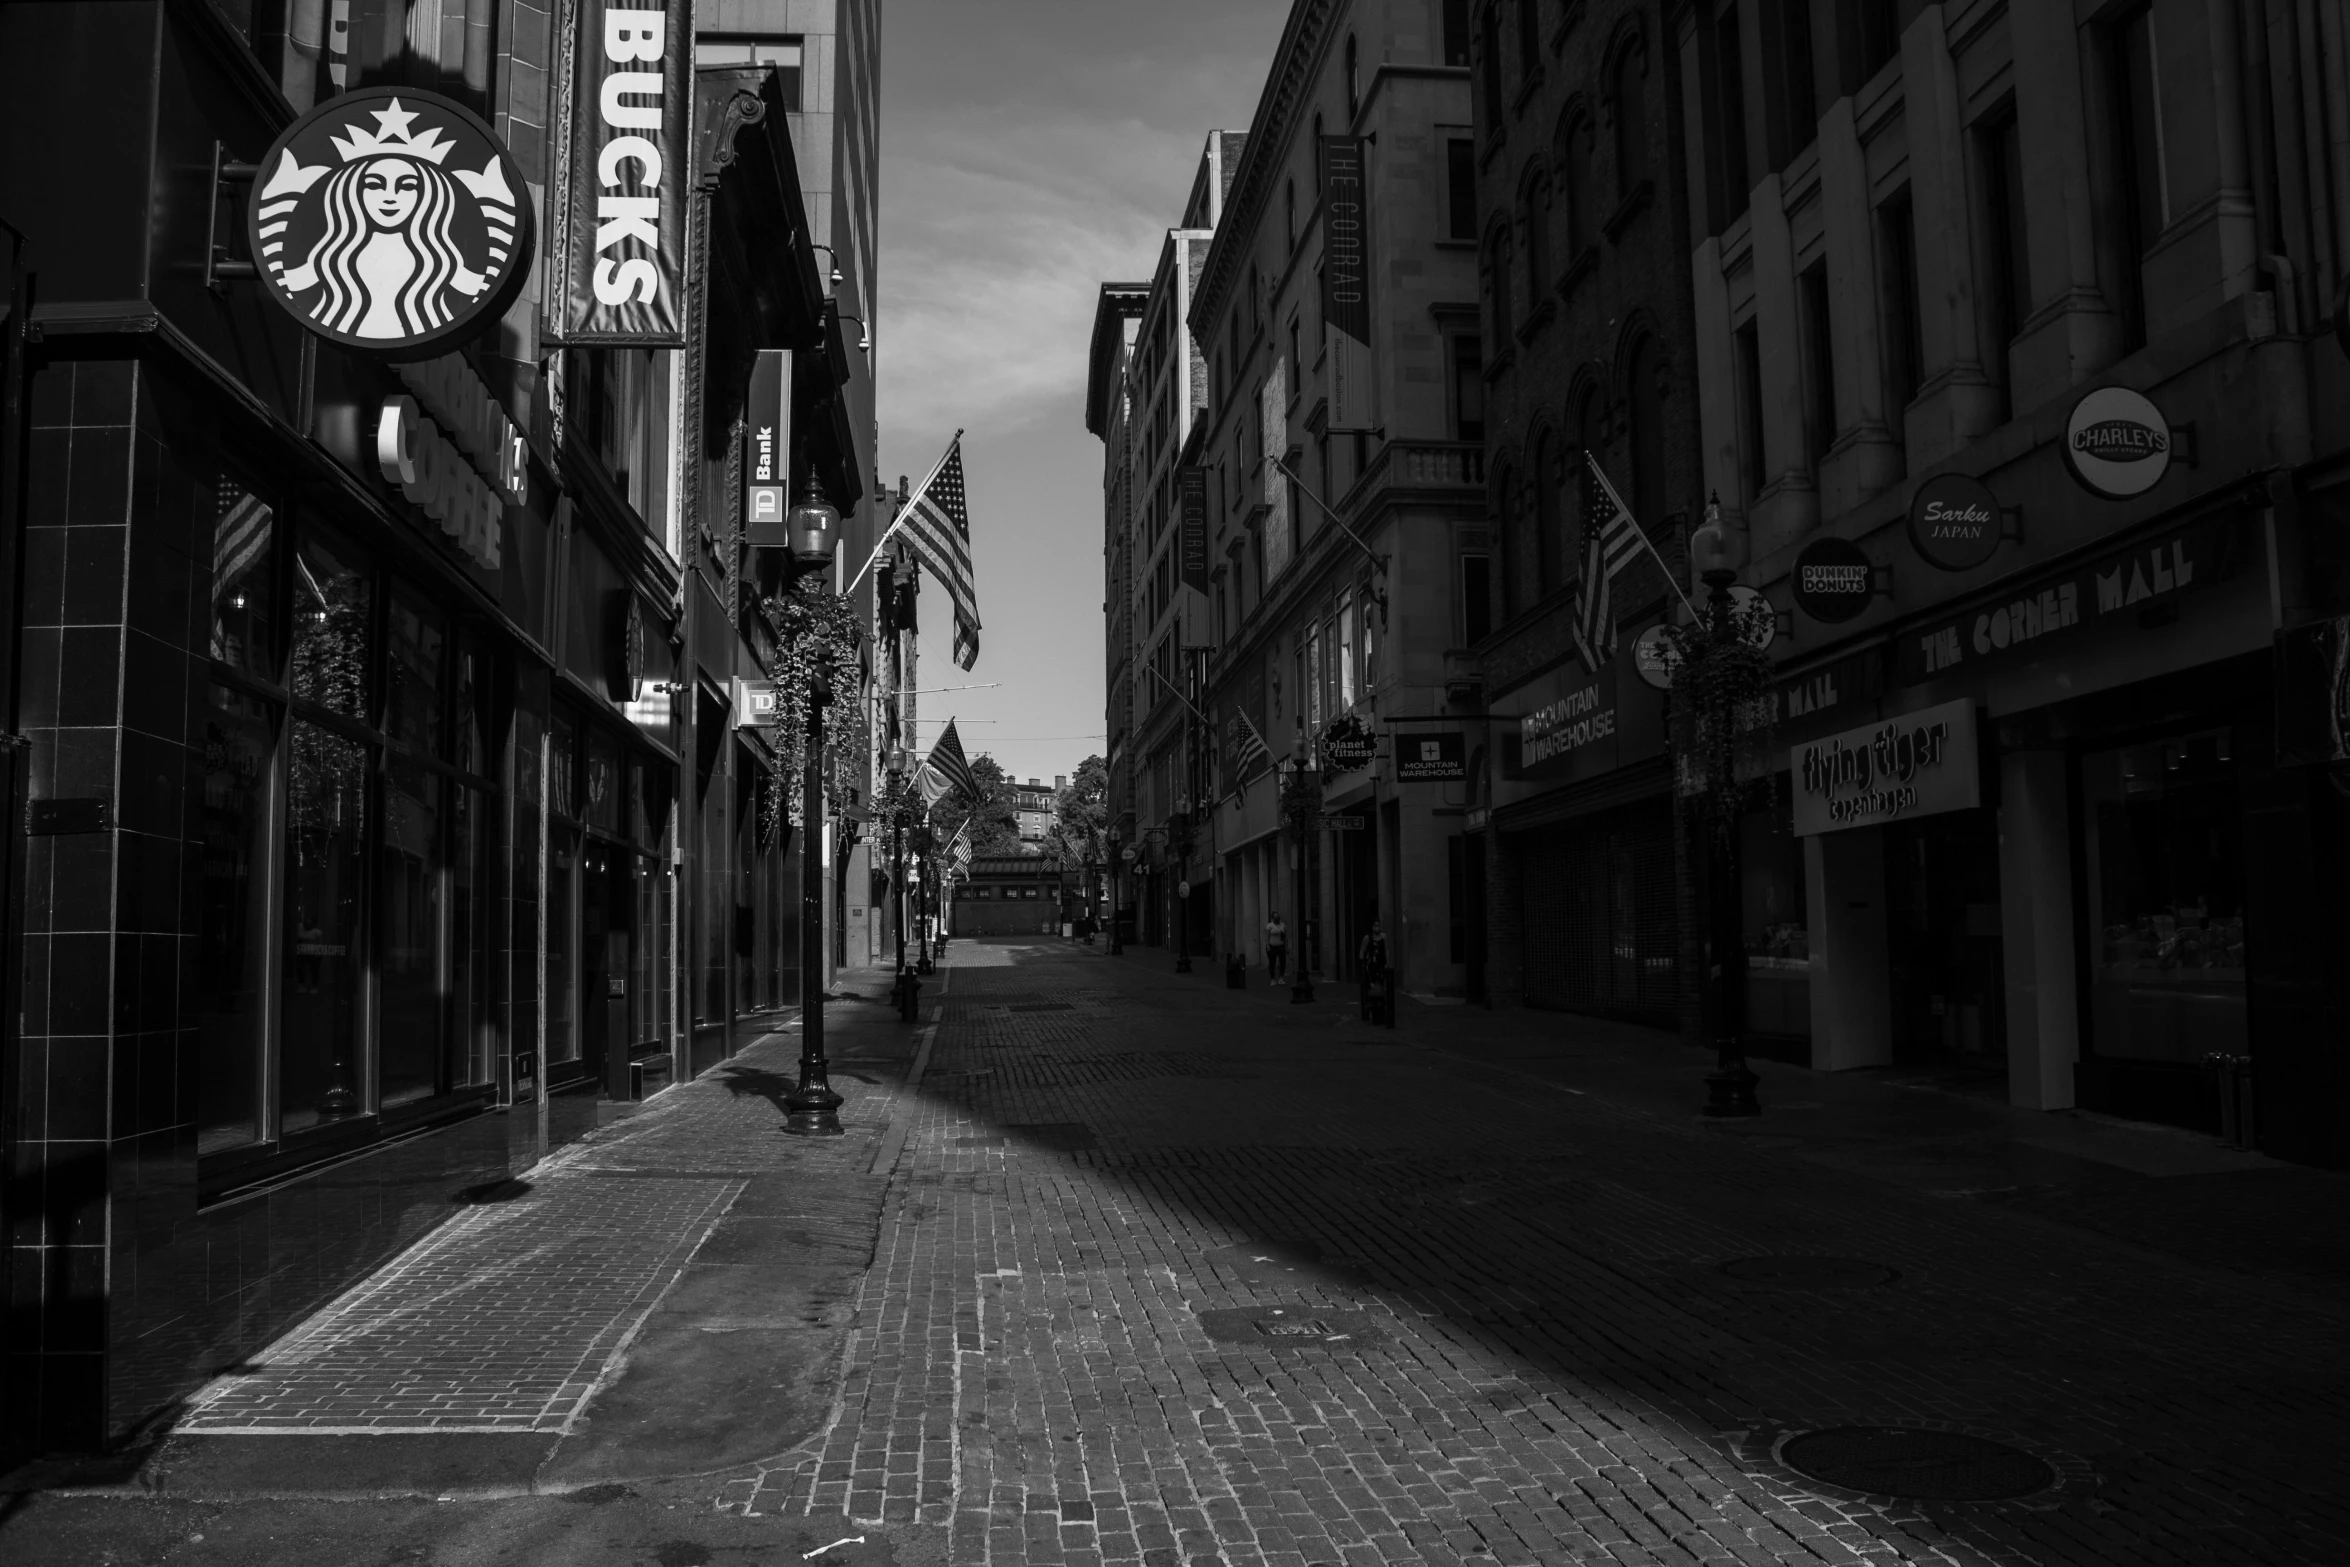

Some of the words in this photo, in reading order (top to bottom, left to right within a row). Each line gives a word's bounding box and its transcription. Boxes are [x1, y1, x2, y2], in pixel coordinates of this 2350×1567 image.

[593, 8, 666, 306] BUCKS
[1330, 143, 1358, 187] THE
[1331, 202, 1361, 303] CONRAD
[756, 426, 772, 480] Bank
[2073, 428, 2167, 452] CHARLEYS
[1185, 471, 1203, 498] THE
[755, 490, 776, 519] TD
[1923, 501, 1991, 522] Sarku
[1185, 508, 1205, 571] CONRAD
[1931, 525, 1982, 538] JAPAN
[1803, 566, 1867, 580] DUNKIN'
[1803, 579, 1866, 593] DONUTS
[1921, 625, 1963, 673] THE
[1973, 581, 2080, 655] CORNER
[2095, 539, 2194, 616] MALL
[751, 694, 774, 710] TD
[1536, 683, 1599, 733] MOUNTAIN
[1788, 672, 1837, 719] MALL
[1329, 740, 1365, 751] planet
[1536, 709, 1615, 761] WAREHOUSE
[1334, 749, 1373, 757] fitness
[1404, 761, 1458, 769] MOUNTAIN
[1803, 738, 1873, 799] flying
[1874, 722, 1947, 783] tiger
[1400, 769, 1464, 777] WAREHOUSE
[1830, 786, 1917, 822] copenhagen
[1331, 818, 1347, 828] HALL
[1133, 864, 1150, 875] 41
